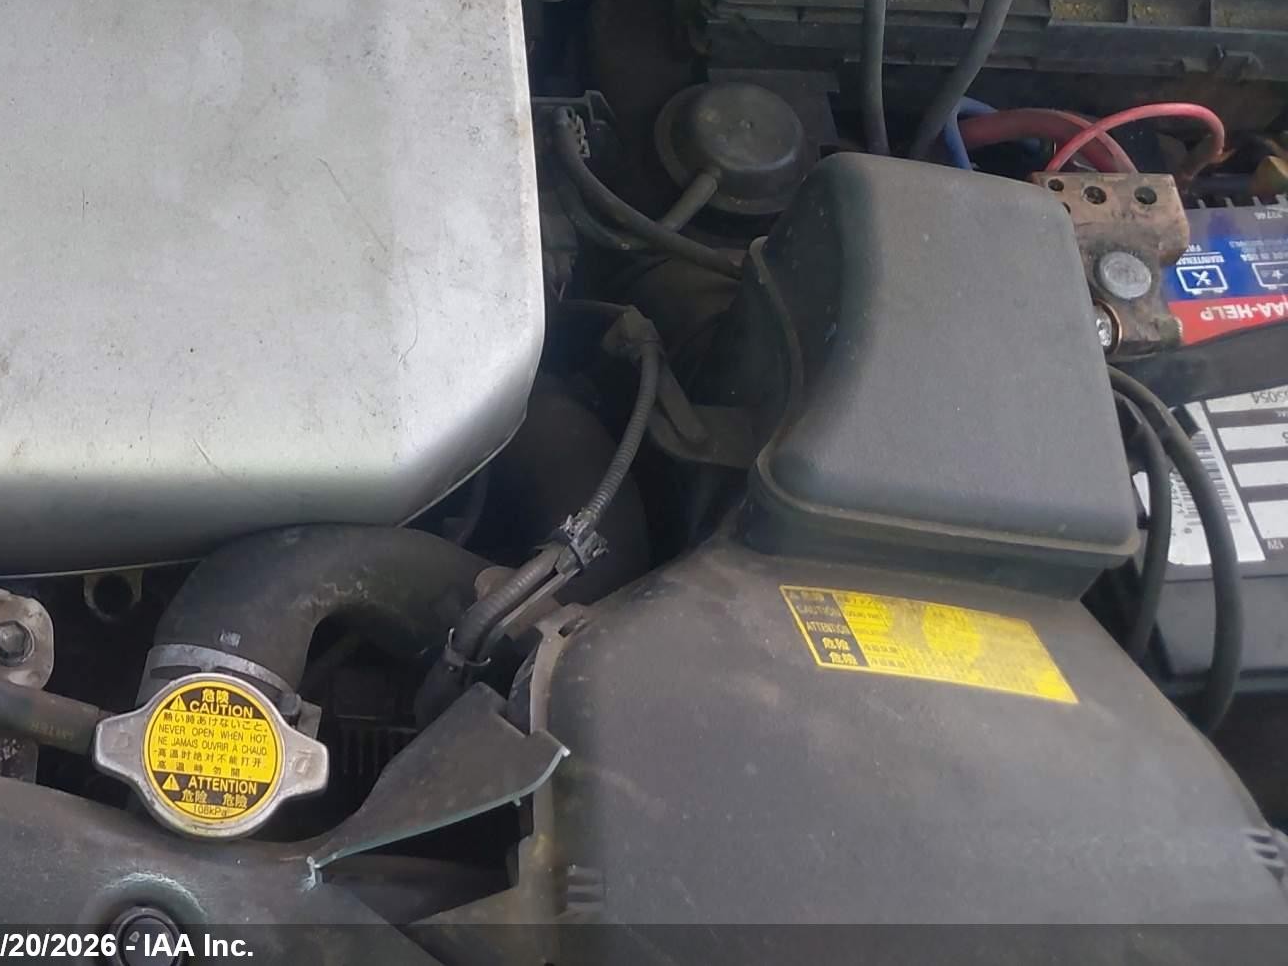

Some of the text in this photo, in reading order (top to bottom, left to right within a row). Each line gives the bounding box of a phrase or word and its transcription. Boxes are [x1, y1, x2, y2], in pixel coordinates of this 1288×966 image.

[189, 701, 253, 718] CAUTION
[158, 724, 186, 736] NEVER
[192, 727, 215, 739] OPEN
[220, 730, 244, 742] WHEN
[158, 736, 170, 746] NE
[171, 737, 199, 749] JAMAIS
[201, 740, 229, 753] OUVRIR
[188, 775, 258, 795] ATTENTION
